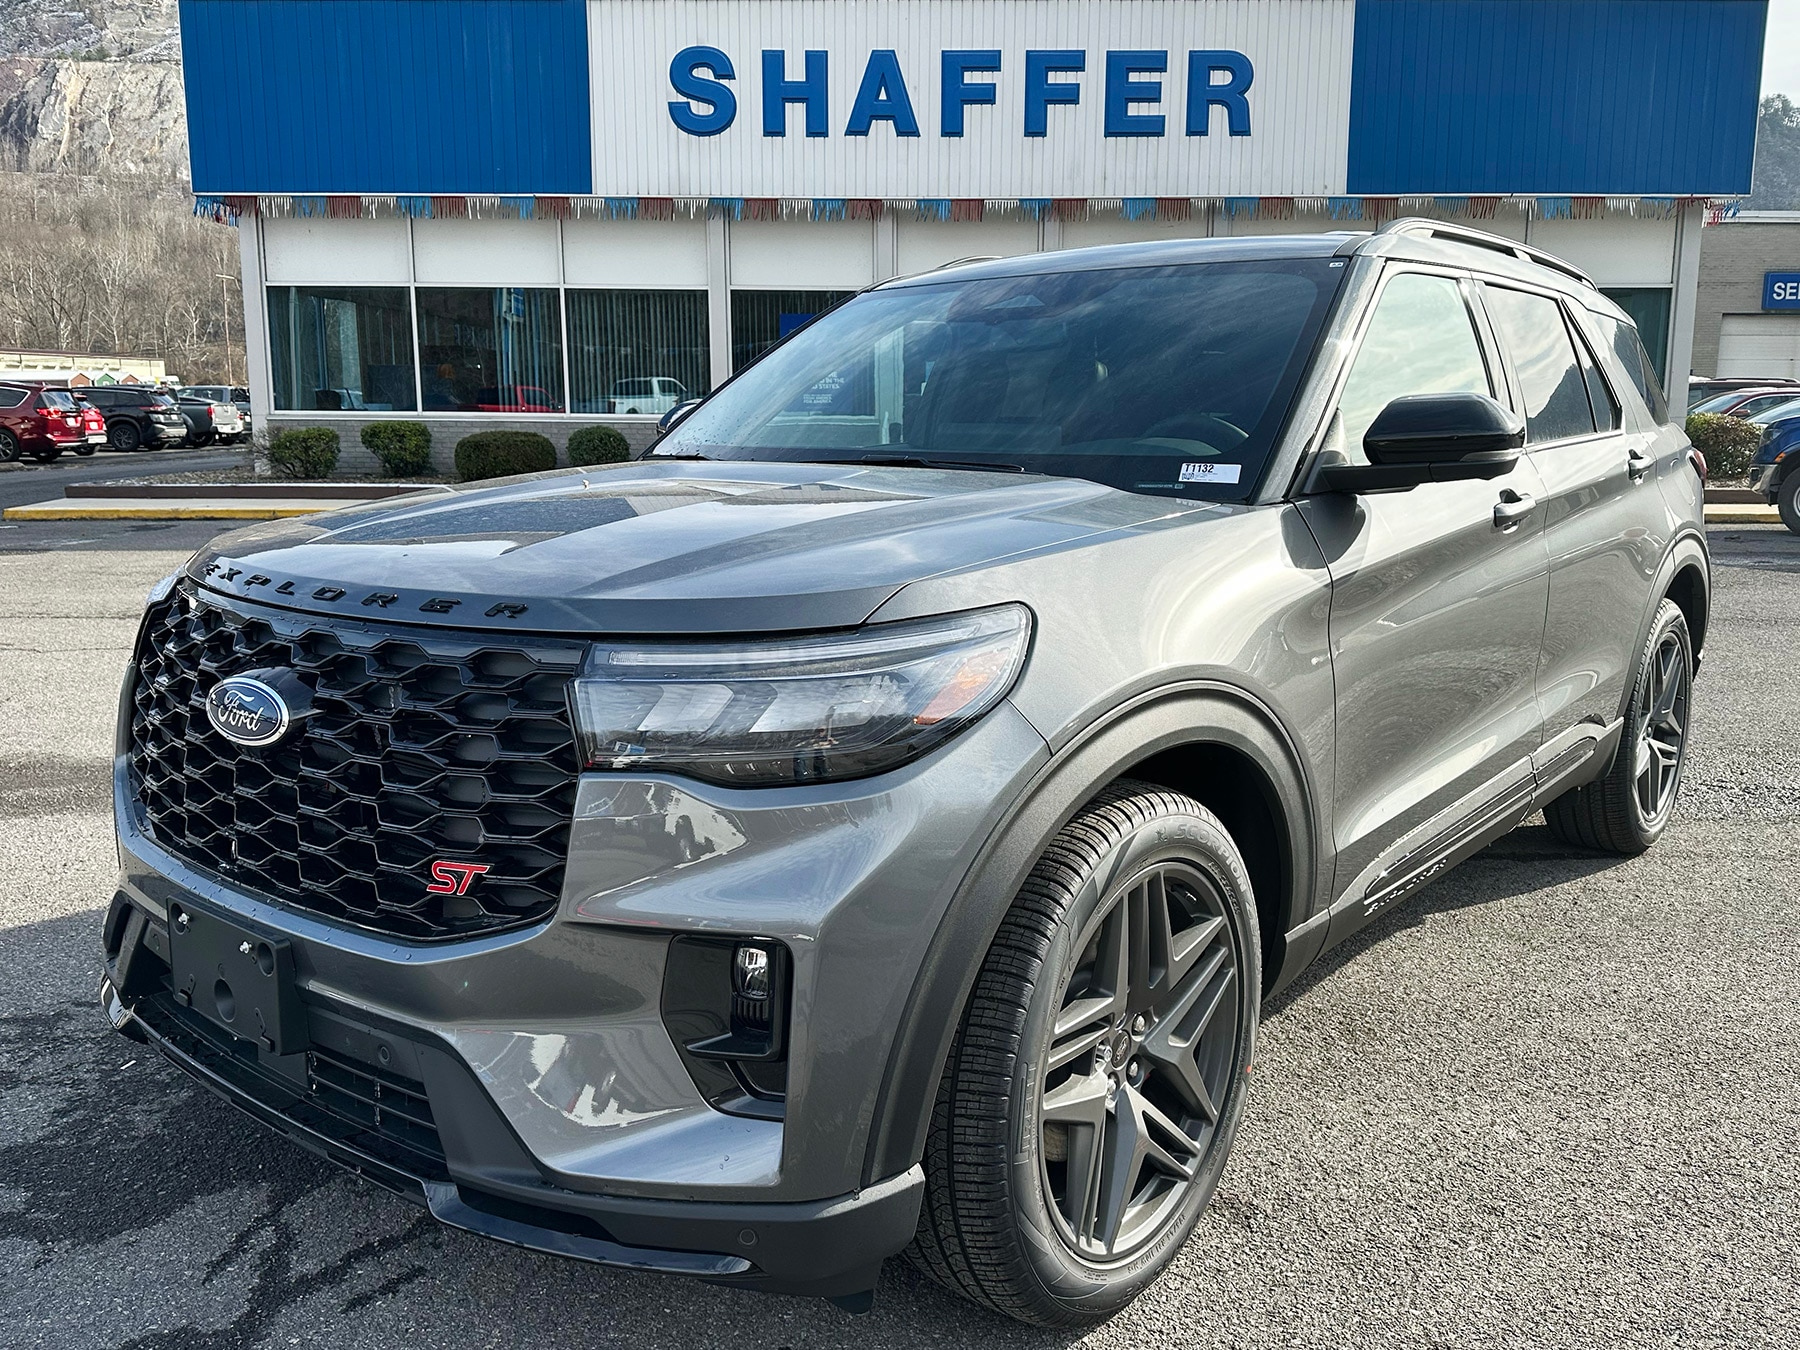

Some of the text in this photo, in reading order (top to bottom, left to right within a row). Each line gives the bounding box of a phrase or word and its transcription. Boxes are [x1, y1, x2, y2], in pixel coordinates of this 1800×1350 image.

[668, 45, 1254, 138] SHAFFER
[1772, 282, 1800, 300] SE
[1185, 463, 1215, 473] T1132
[203, 561, 529, 619] EXPLORER
[218, 689, 265, 731] Ford
[426, 860, 490, 895] ST
[1173, 823, 1248, 893] SCORPION
